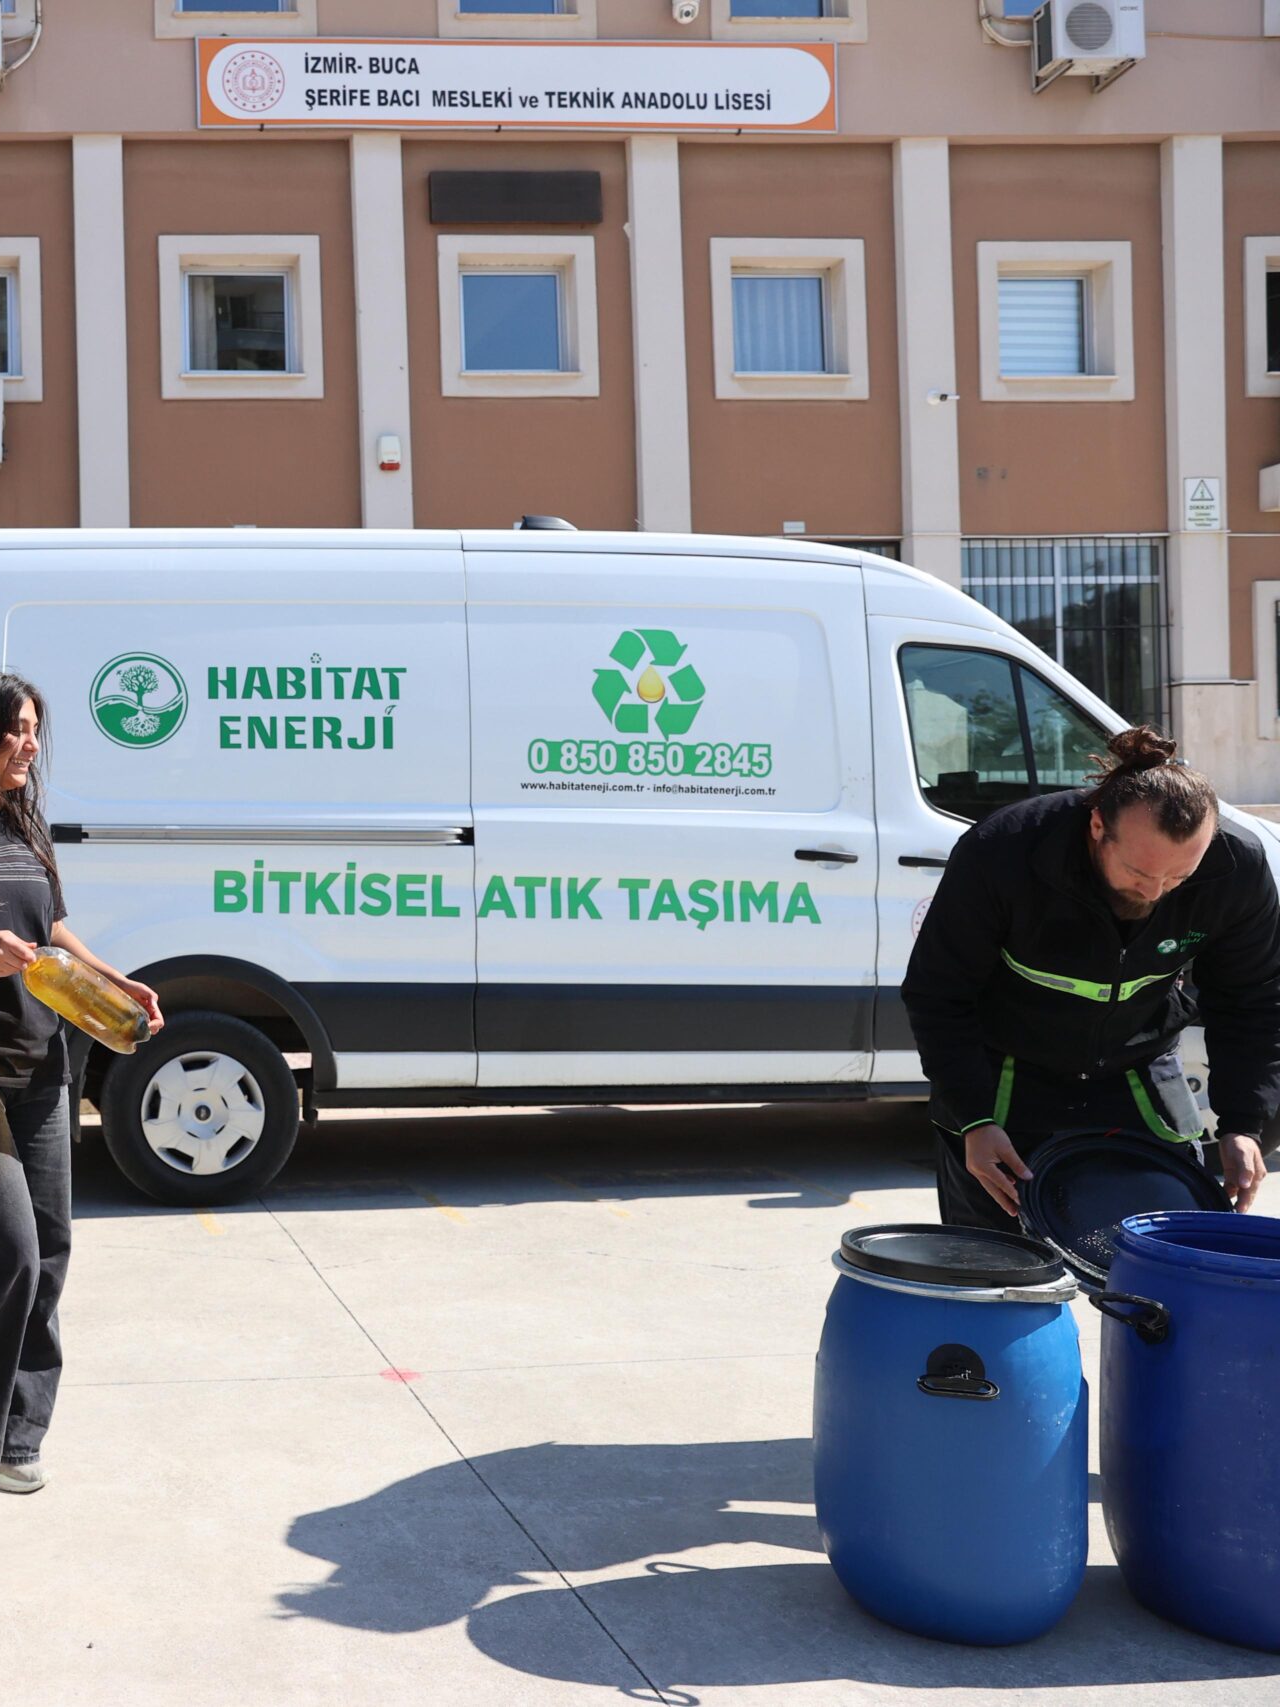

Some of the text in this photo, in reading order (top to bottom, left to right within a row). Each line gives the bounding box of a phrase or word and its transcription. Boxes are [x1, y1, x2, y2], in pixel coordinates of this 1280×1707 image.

[304, 52, 420, 75] İZMİR- BUCA
[304, 85, 772, 111] ŞERİFE BACI MESLEKİ ve TEKNİK ANADOLU LİSESİ
[208, 653, 408, 700] HABİTAT
[219, 705, 397, 750] ENERJİ
[529, 740, 771, 776] 0 850 850 2845
[520, 781, 645, 793] www.habitateneji.com.tr
[653, 783, 777, 797] info@habitatenerji.com.tr
[213, 859, 823, 931] BİTKİSEL ATIK TAŞIMA
